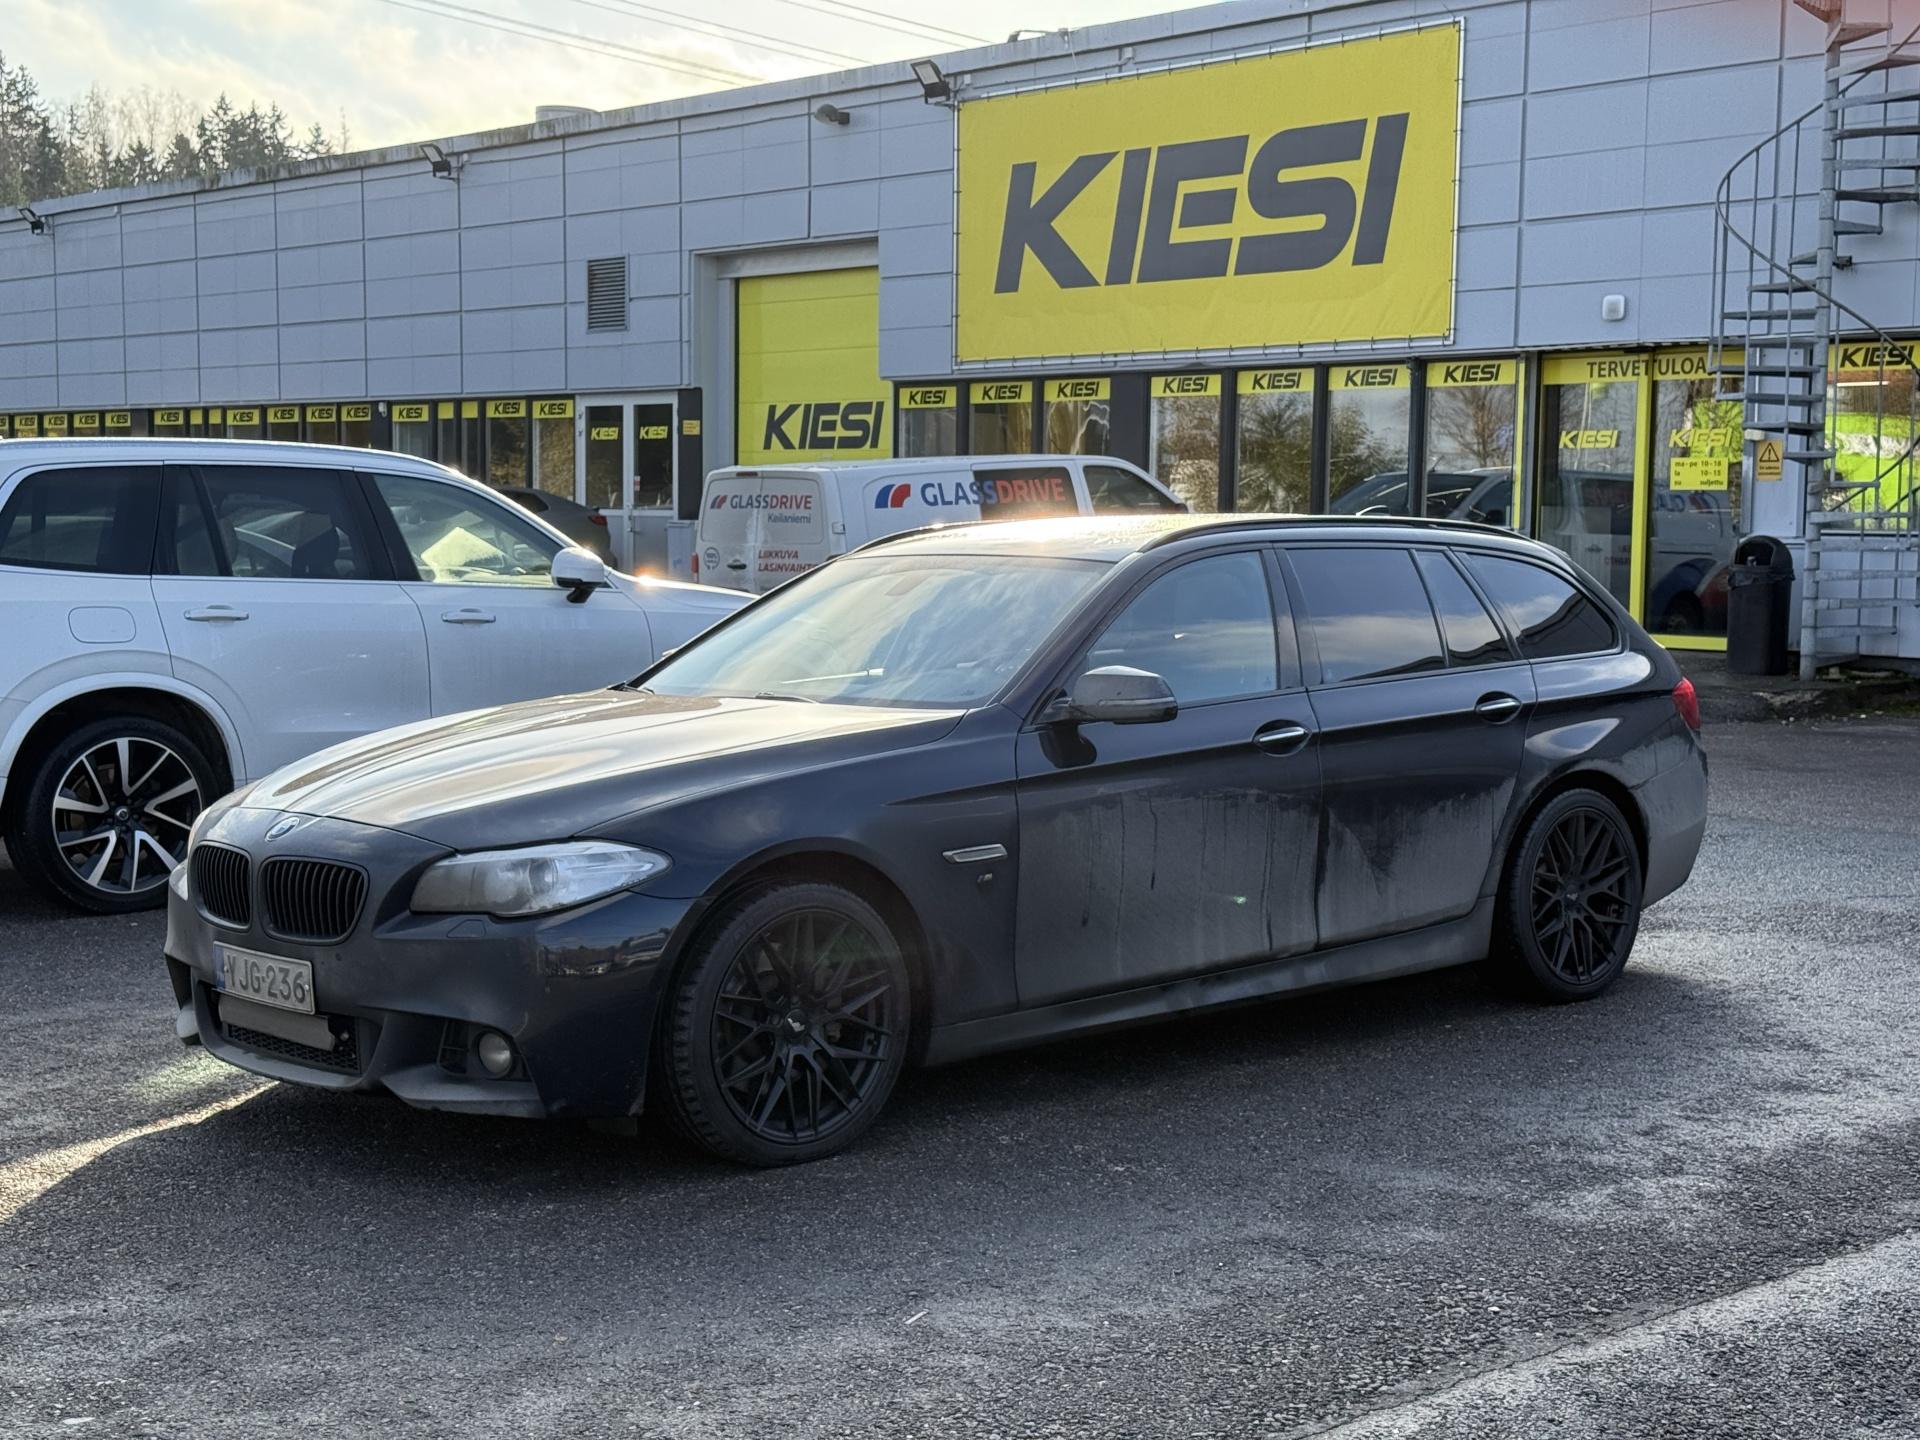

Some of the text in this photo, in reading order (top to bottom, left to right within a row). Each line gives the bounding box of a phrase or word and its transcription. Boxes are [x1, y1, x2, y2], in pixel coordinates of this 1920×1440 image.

[994, 112, 1410, 294] KIESI
[1840, 345, 1914, 368] KIESI
[1444, 363, 1501, 384] KIESI
[1587, 356, 1706, 378] TERVETULOA
[1163, 375, 1209, 393] KIESI
[1252, 371, 1302, 390] KIESI
[1344, 368, 1398, 388] KIESI
[909, 390, 947, 405] KIESI
[982, 385, 1023, 400] KIESI
[1057, 381, 1100, 398] KIESI
[346, 407, 370, 419] KIESI
[398, 407, 423, 419] KIESI
[494, 402, 521, 415] KIESI
[539, 402, 567, 416] KIESI
[590, 427, 619, 440] KIESI
[639, 425, 669, 439] KIESI
[763, 401, 885, 450] KIESI
[1559, 430, 1618, 449] KIESI
[1669, 427, 1734, 448] KIESI
[920, 478, 1066, 507] GLASSDRIVE
[730, 494, 813, 510] GLASSDRIVE
[767, 512, 812, 524] Keilaniemi
[758, 550, 799, 559] LIIKKUVA
[227, 954, 306, 1003] YJG-236
